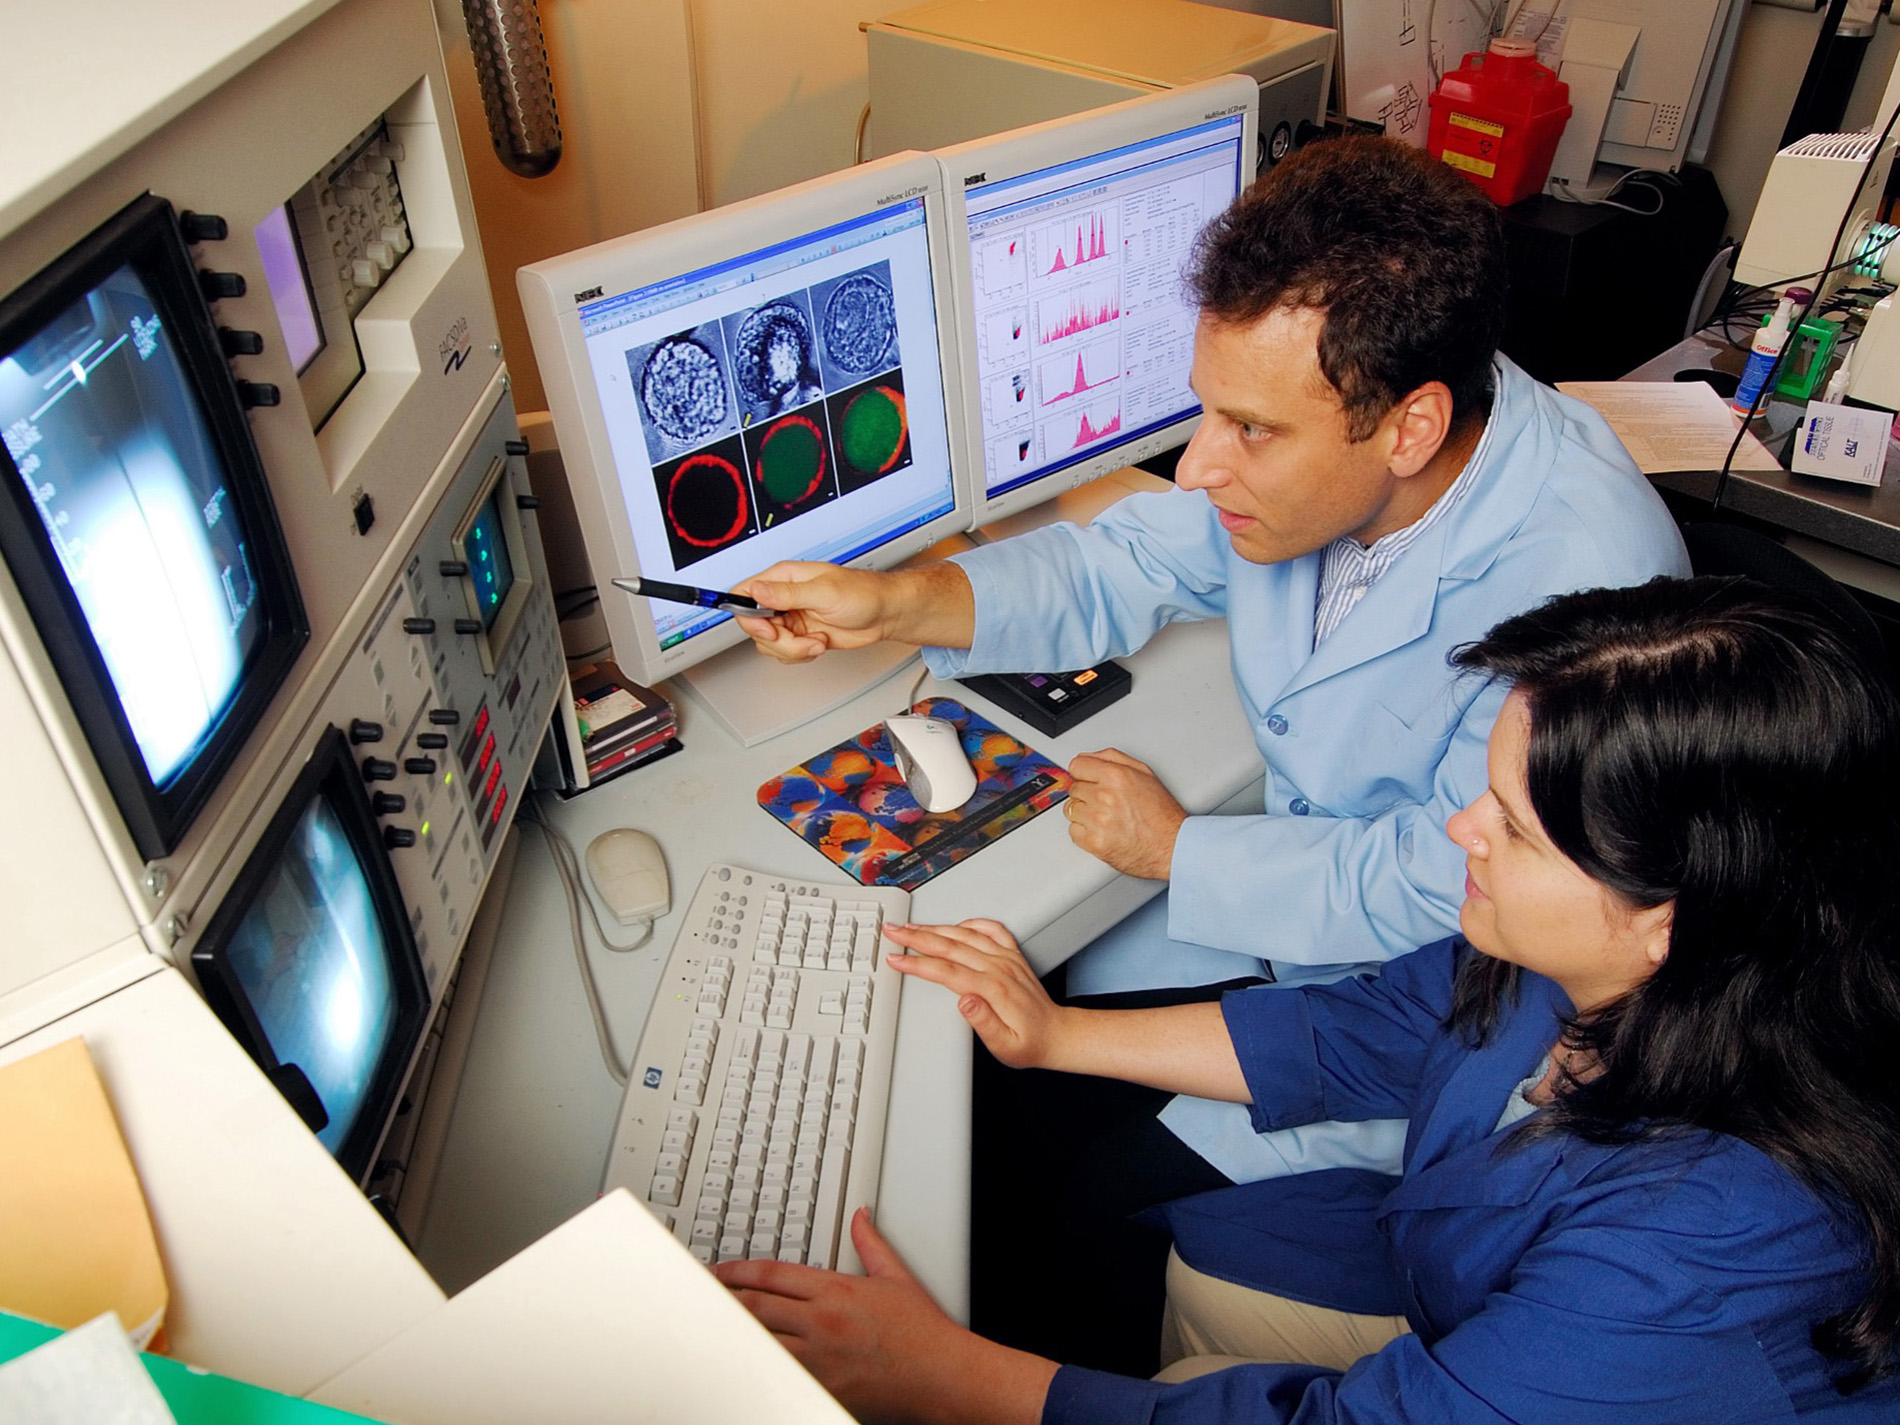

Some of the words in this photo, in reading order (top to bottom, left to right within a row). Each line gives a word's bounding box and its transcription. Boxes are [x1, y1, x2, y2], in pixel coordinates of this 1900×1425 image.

[964, 172, 986, 187] NEC
[877, 192, 904, 206] MultiSync
[904, 186, 918, 198] LCD
[574, 285, 604, 304] NEC
[1756, 344, 1778, 354] Office
[1823, 415, 1834, 436] TISSUE
[1817, 436, 1831, 461] OPTICAL
[1844, 438, 1857, 458] KALT
